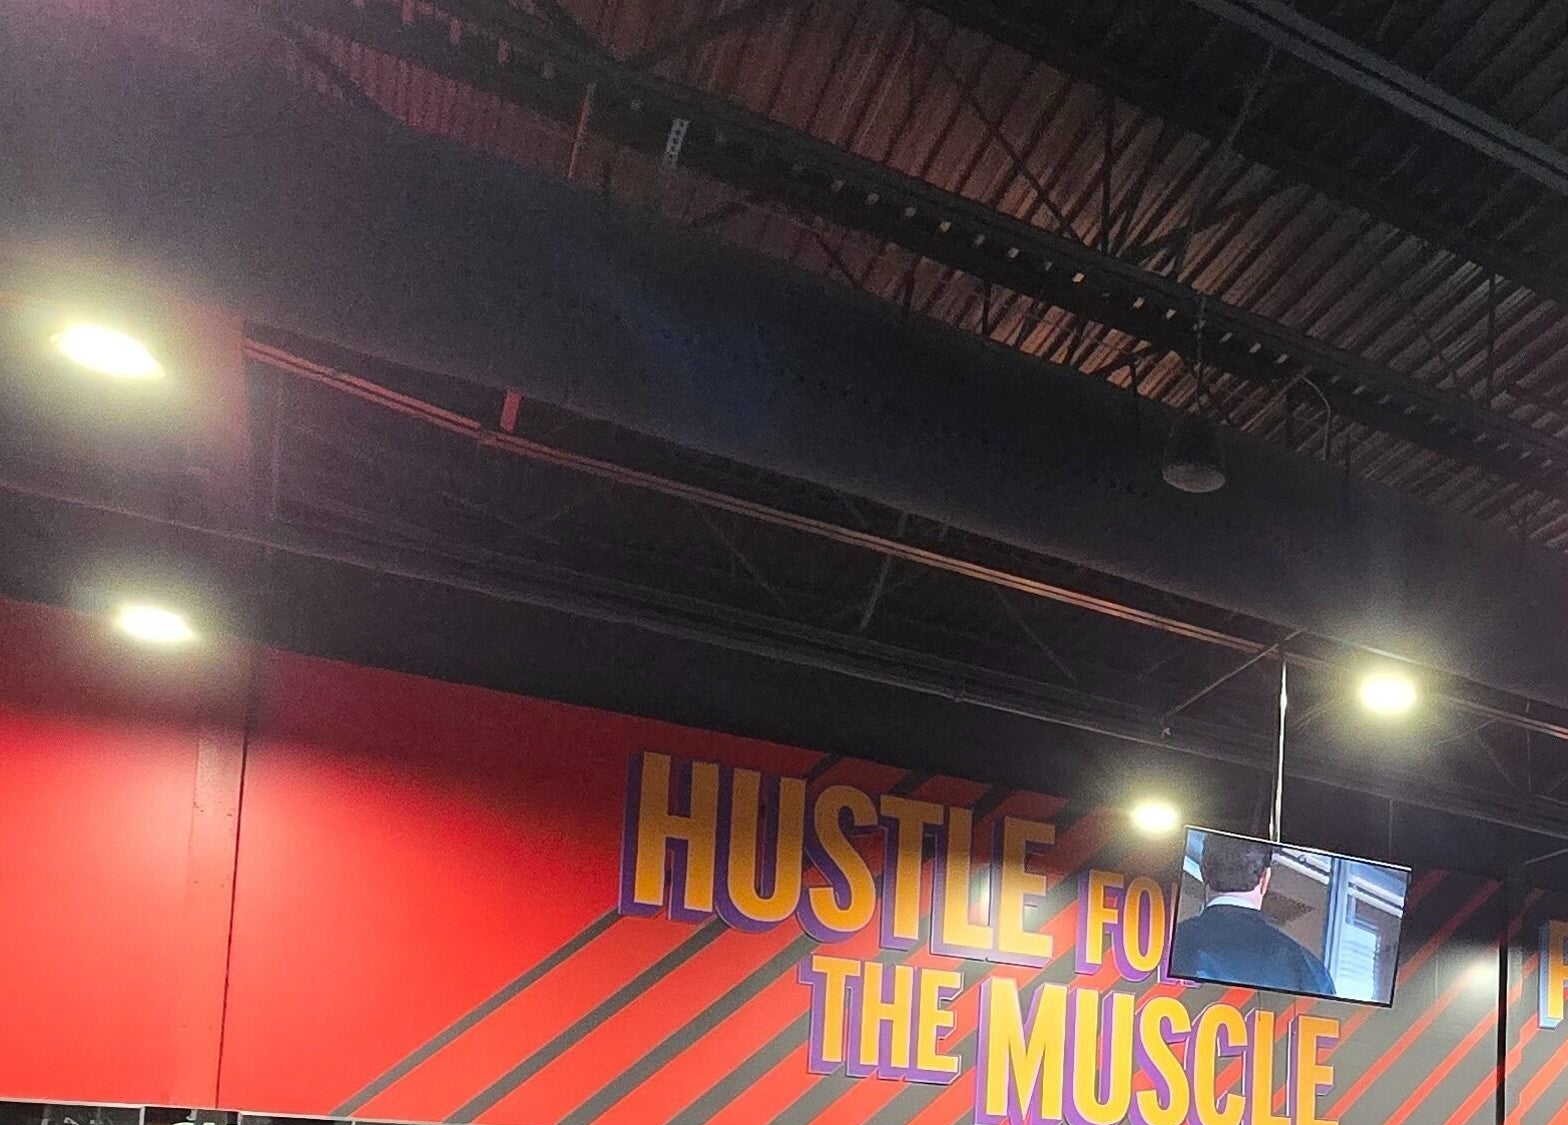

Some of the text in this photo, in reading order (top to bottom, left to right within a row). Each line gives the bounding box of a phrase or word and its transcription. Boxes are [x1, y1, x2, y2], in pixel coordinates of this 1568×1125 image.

[620, 751, 1197, 985] HUSTLE FO
[803, 955, 961, 1083] THE
